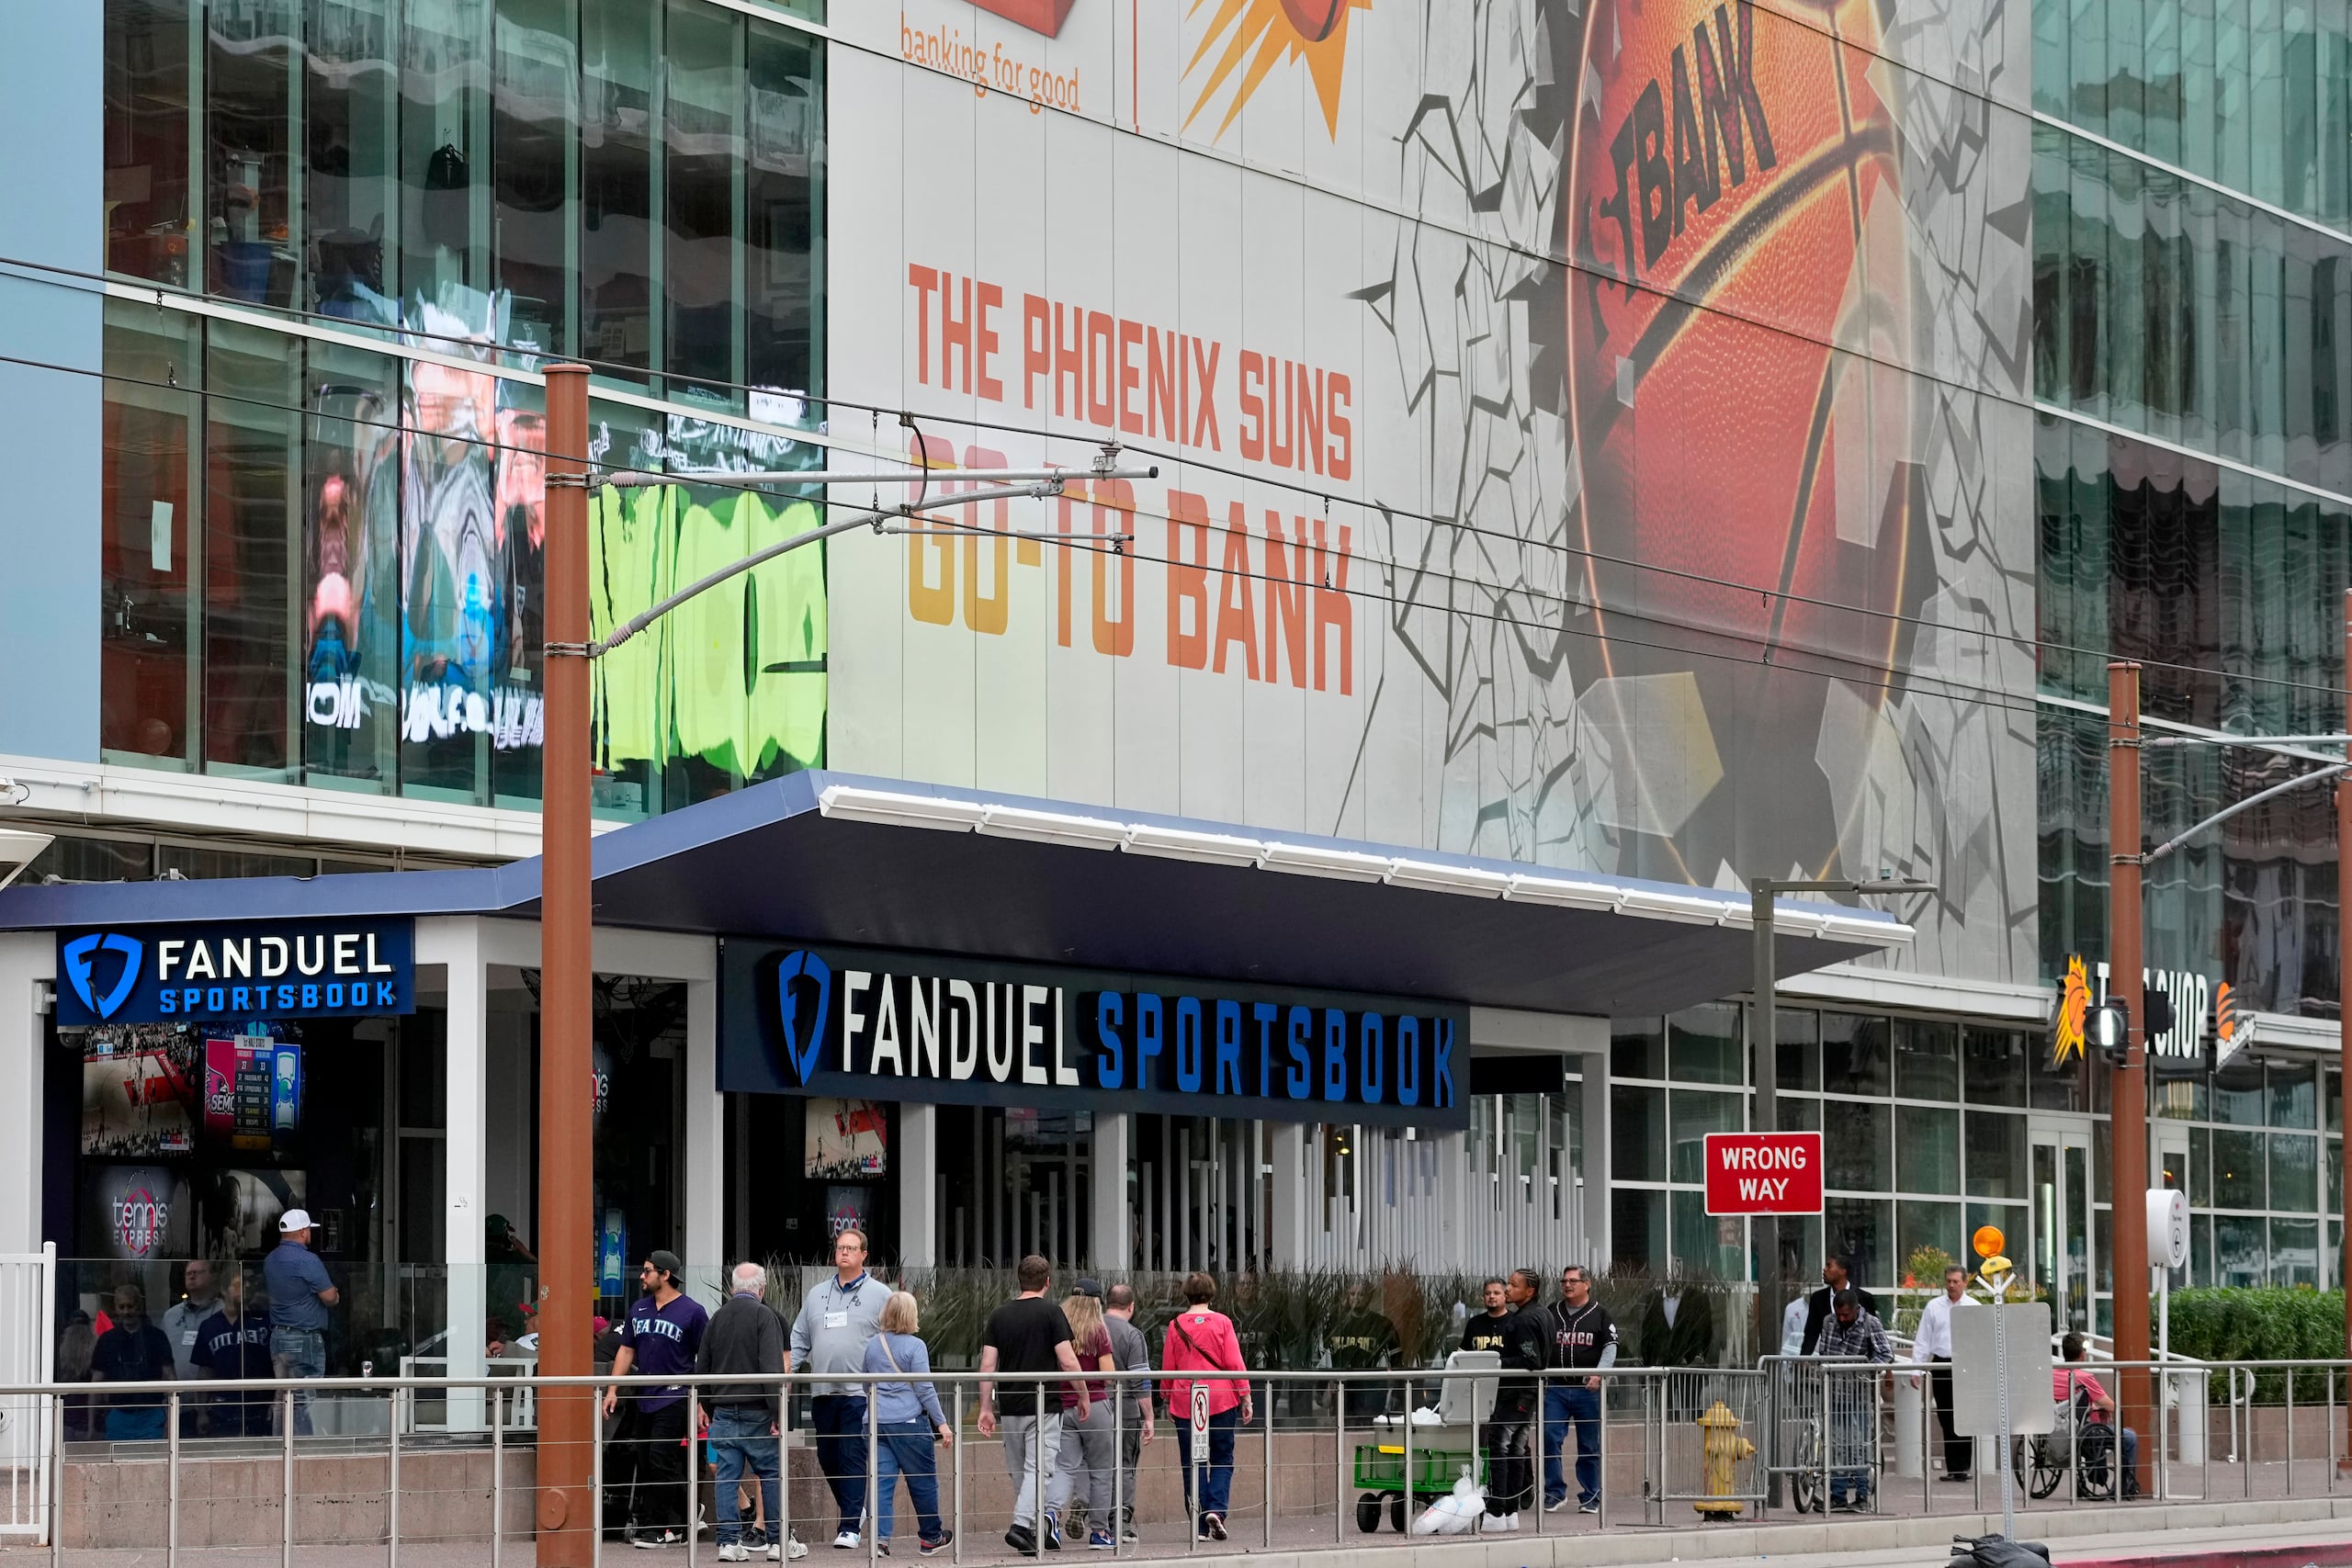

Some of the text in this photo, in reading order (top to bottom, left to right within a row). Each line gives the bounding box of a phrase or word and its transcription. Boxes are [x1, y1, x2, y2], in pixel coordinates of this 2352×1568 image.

[900, 10, 1080, 115] banking for good
[909, 263, 1351, 481] THE PHOENIX SUNS
[909, 433, 1352, 696] GO-TO BANK
[158, 932, 392, 981] FANDUEL
[159, 980, 395, 1013] SPORTSBOOK
[842, 969, 1455, 1110] FANDUEL SPORTSBOOK
[1721, 1145, 1807, 1170] WRONG
[1738, 1178, 1790, 1201] WAY
[112, 1196, 168, 1228] tennis
[113, 1230, 167, 1246] EXPRESS
[631, 1316, 684, 1343] SEATTLE
